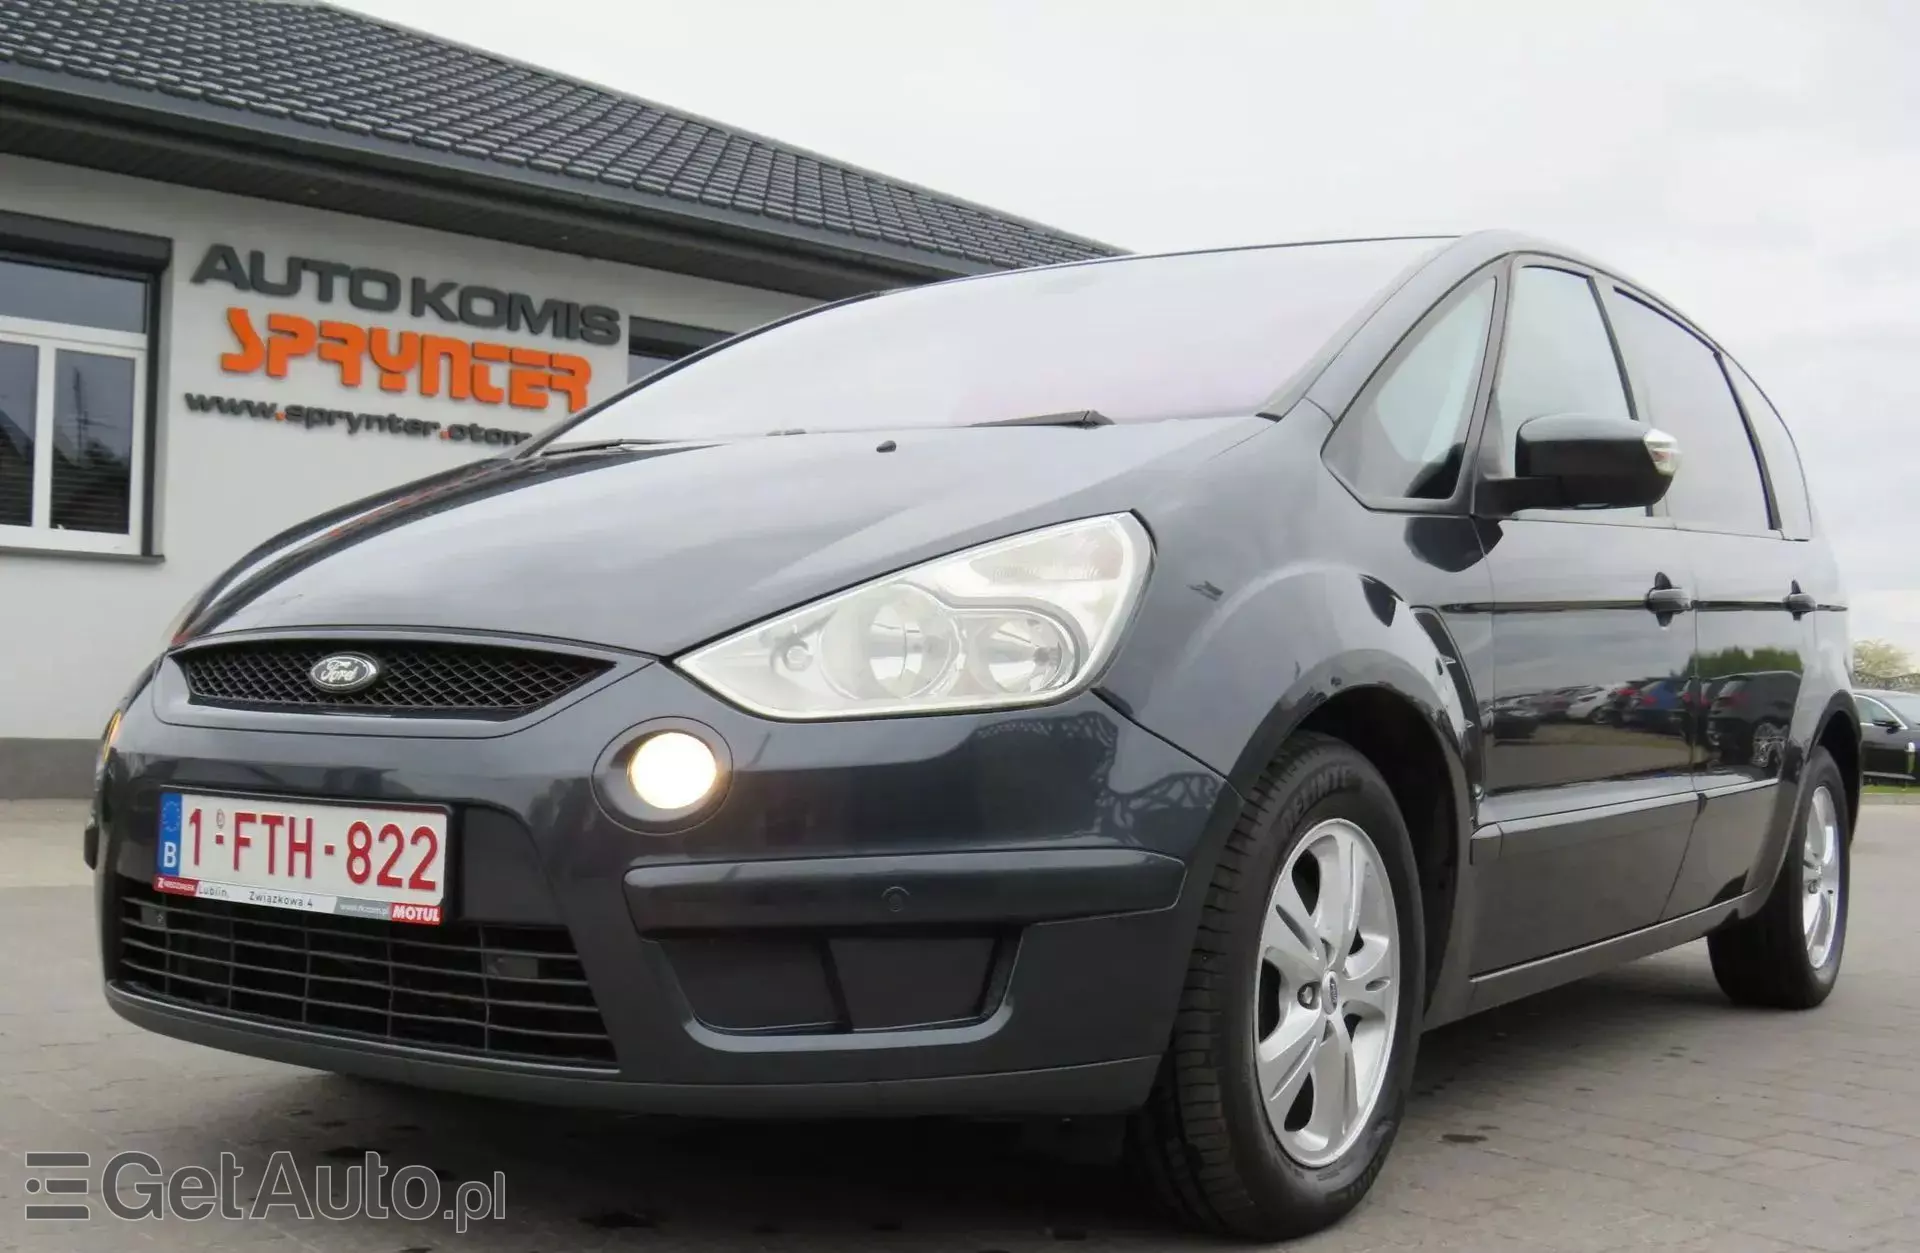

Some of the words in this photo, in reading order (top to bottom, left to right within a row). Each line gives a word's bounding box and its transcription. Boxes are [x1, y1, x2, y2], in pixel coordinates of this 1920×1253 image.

[191, 243, 400, 312] AUTO
[410, 277, 621, 345] KOMIS
[220, 307, 592, 413] SPRYNTER
[321, 660, 358, 682] Ford
[163, 841, 177, 868] B
[188, 807, 438, 892] 1-FTH-822
[392, 904, 440, 923] MOTUL
